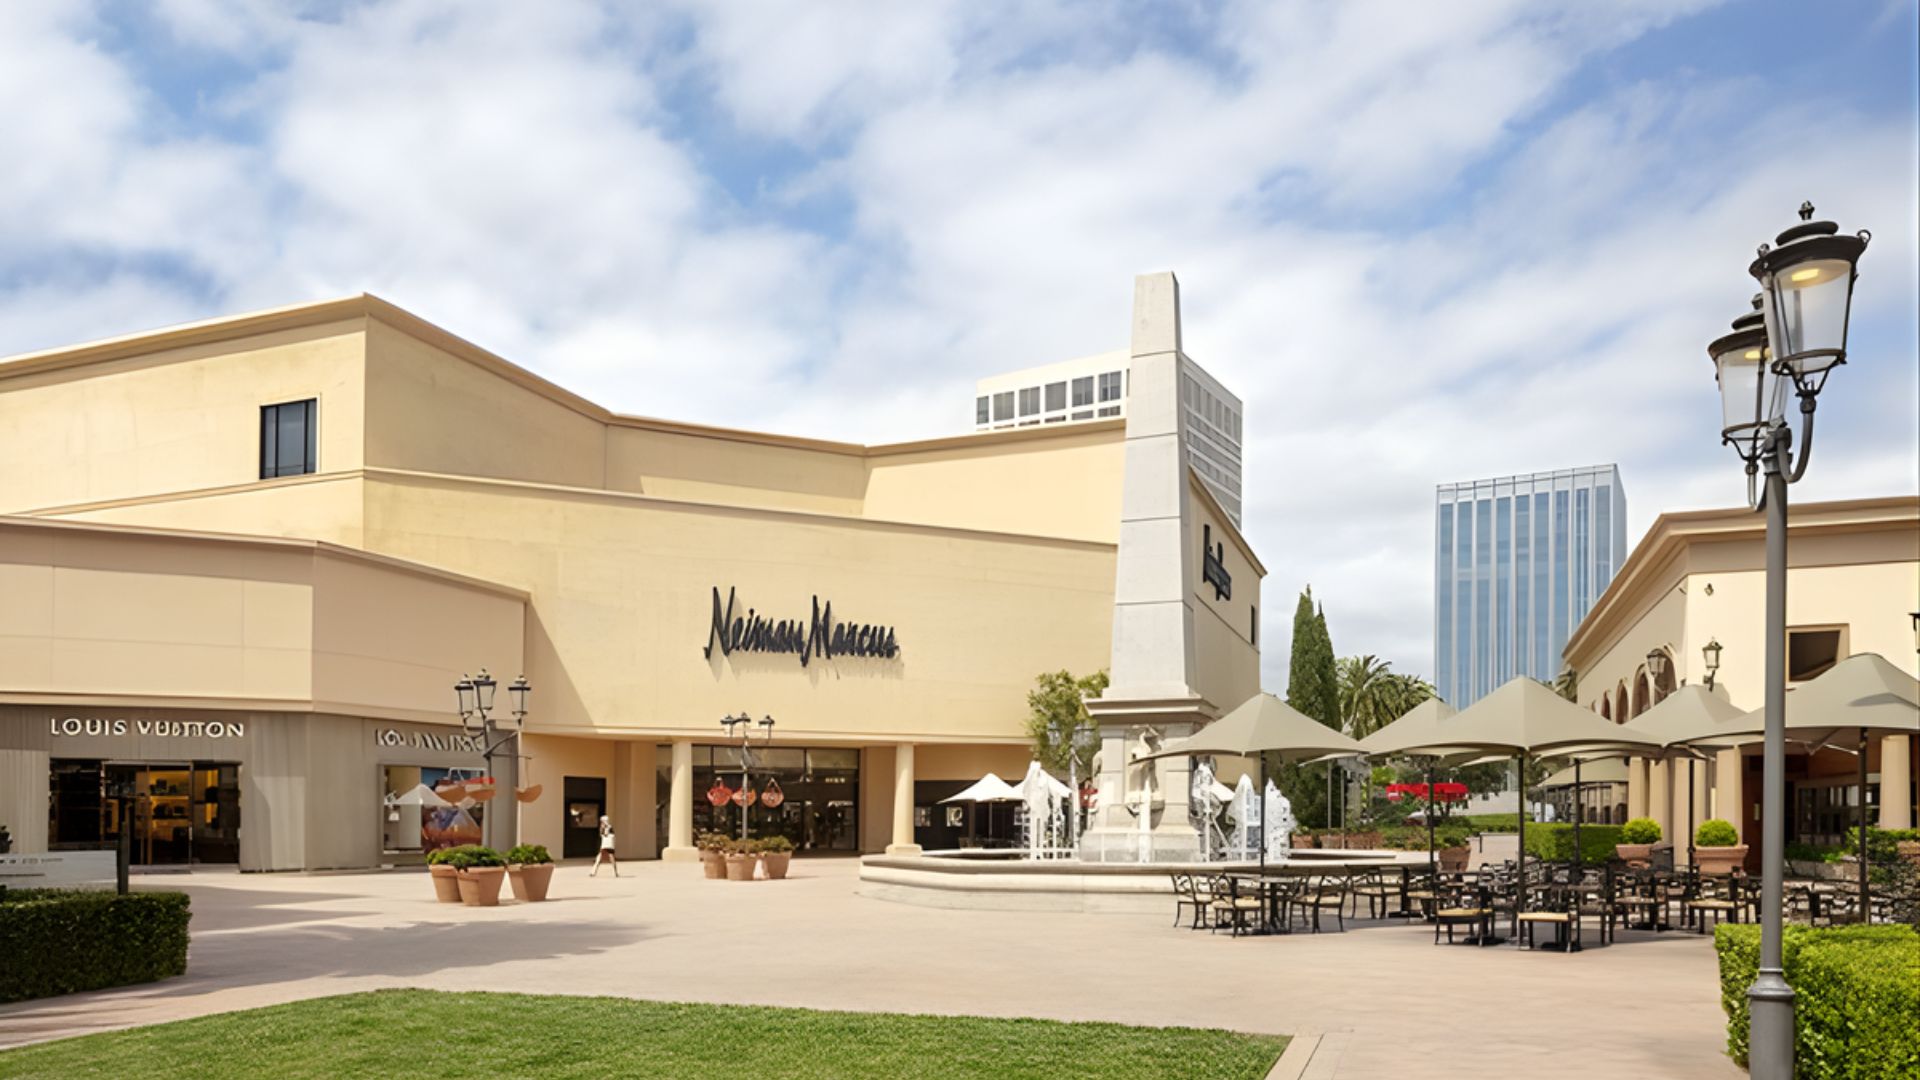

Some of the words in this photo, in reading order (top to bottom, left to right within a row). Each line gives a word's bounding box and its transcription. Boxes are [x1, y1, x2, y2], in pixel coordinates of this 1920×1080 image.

[703, 586, 805, 660] Neiman
[801, 594, 900, 667] Marcus
[50, 718, 127, 736] LOUIS
